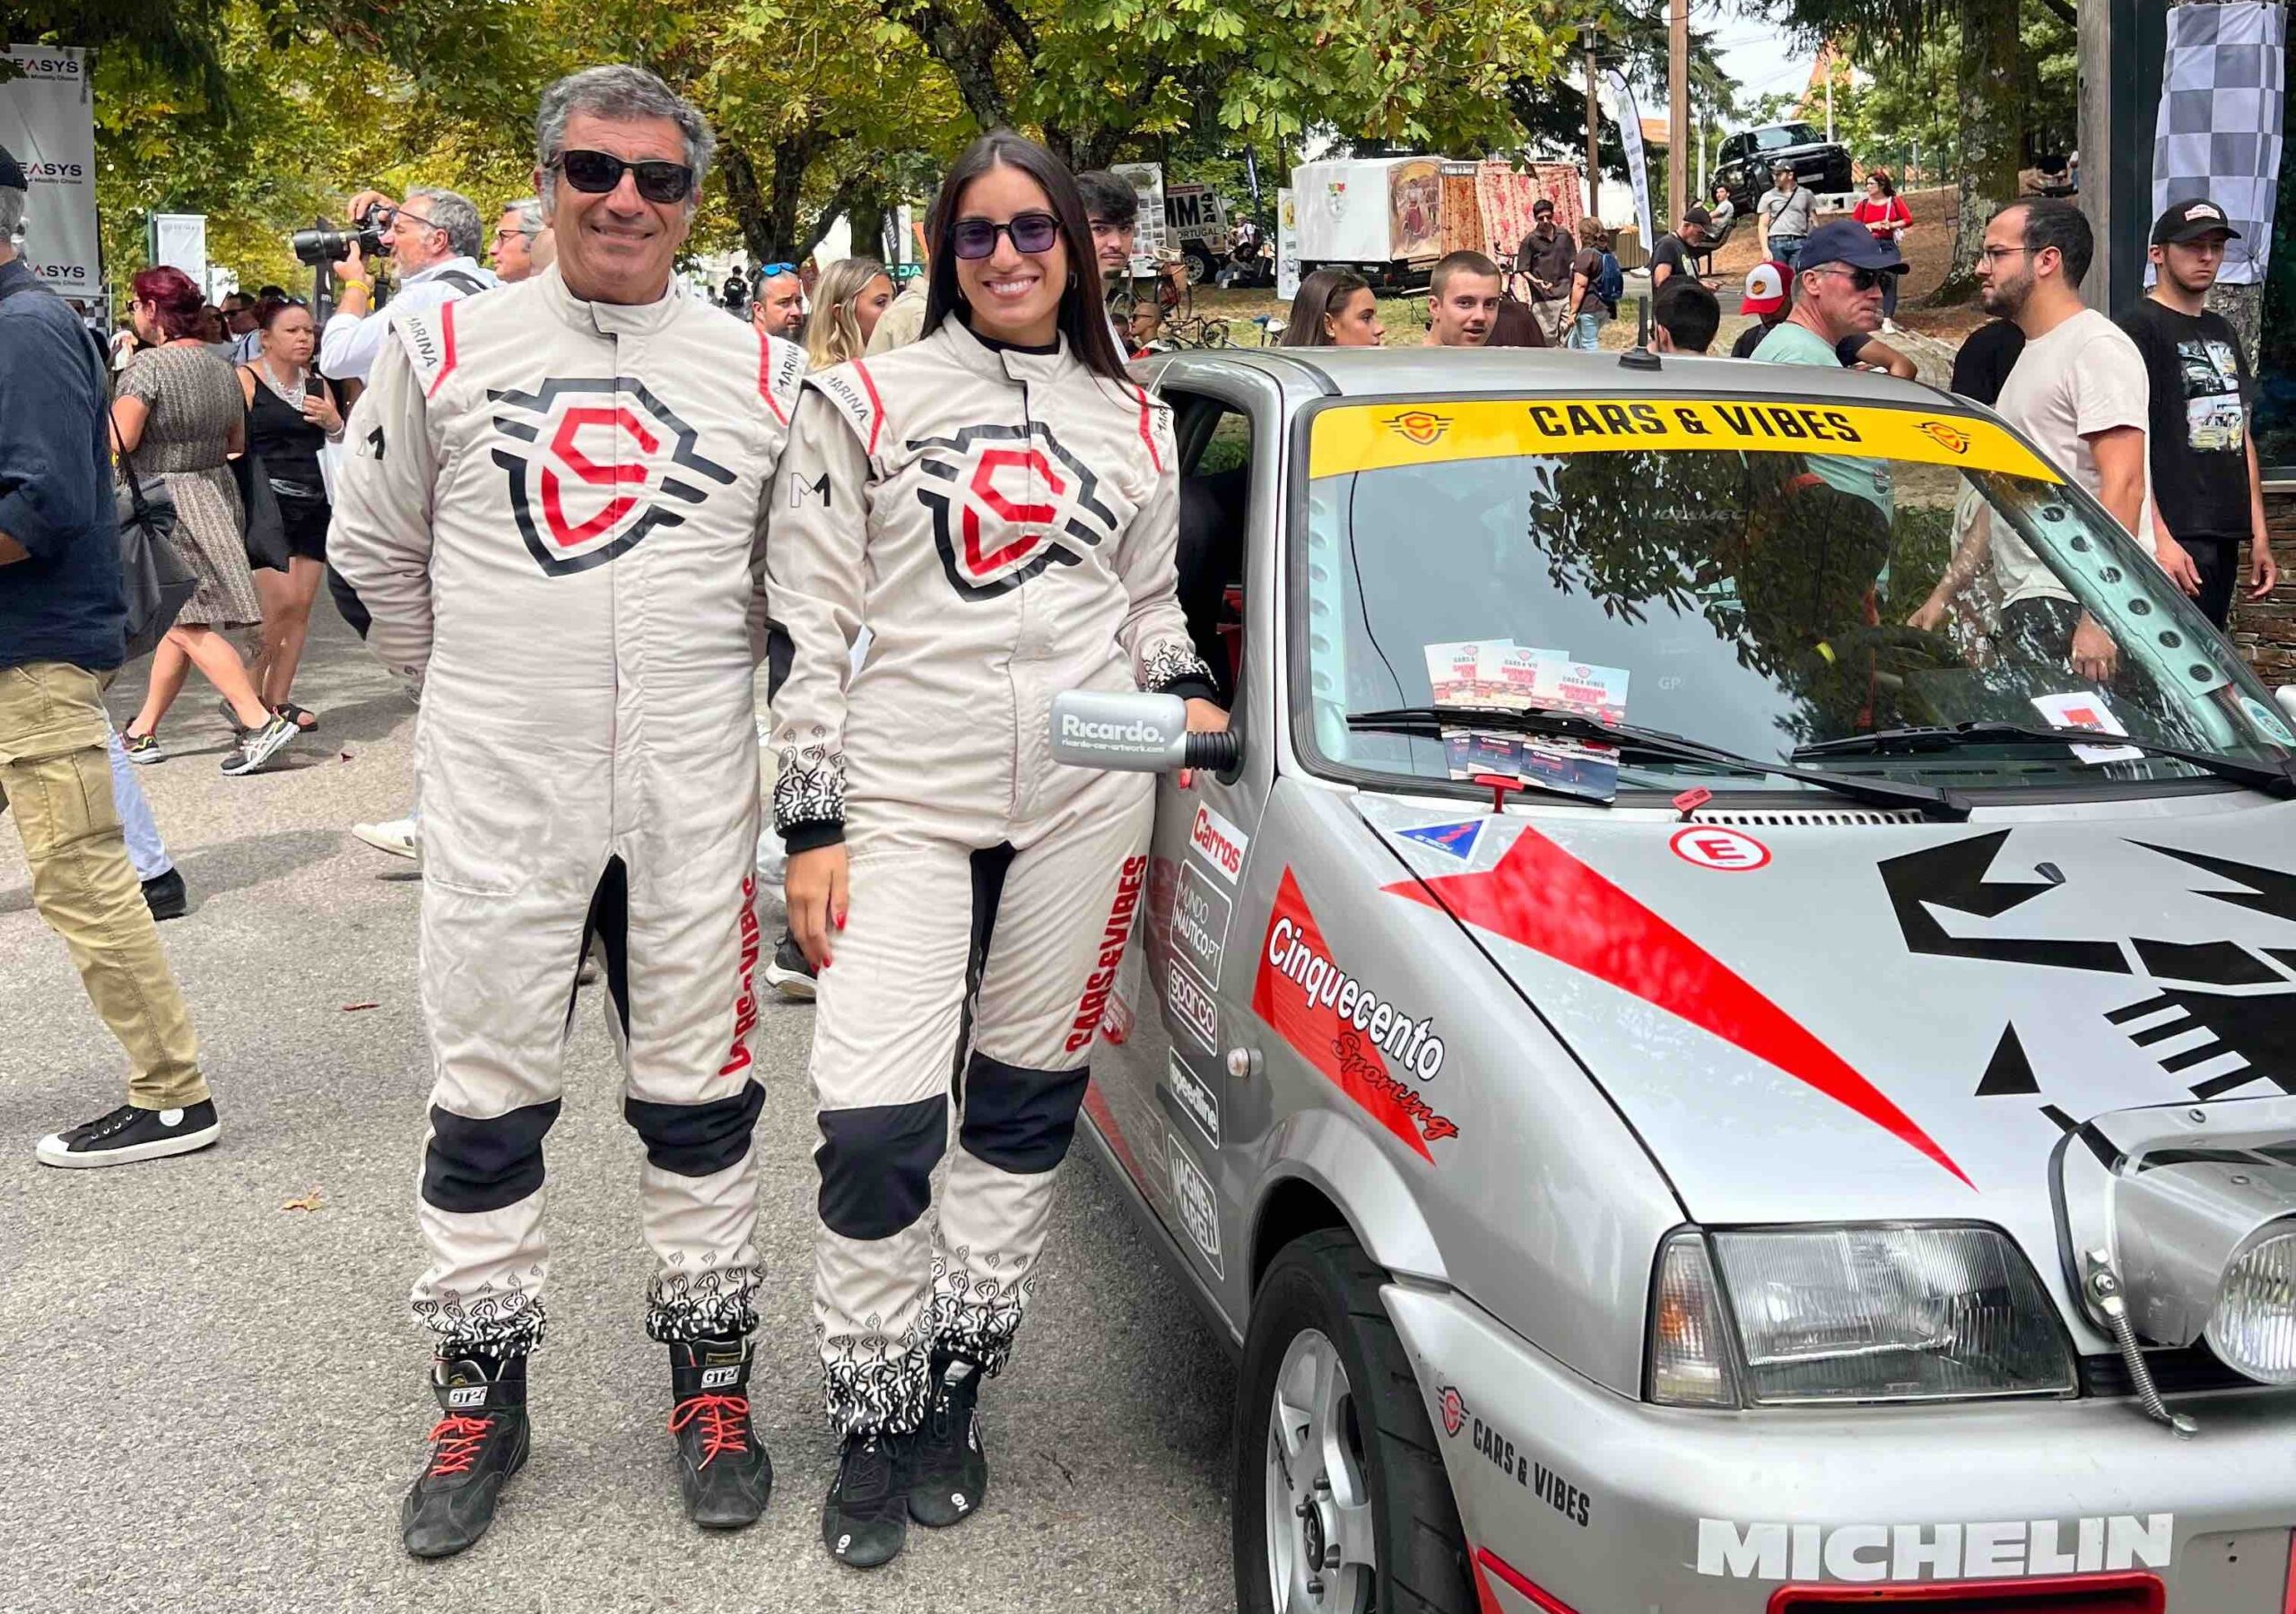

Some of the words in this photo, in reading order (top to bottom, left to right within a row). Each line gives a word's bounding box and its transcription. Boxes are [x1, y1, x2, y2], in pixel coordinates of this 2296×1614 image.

[16, 161, 83, 177] EASYS
[1177, 227, 1220, 239] ORTUGAL
[1528, 404, 1668, 436] CARS
[1673, 408, 1713, 435] &
[1712, 404, 1862, 442] VIBES
[1062, 713, 1165, 743] Ricardo.
[1194, 808, 1240, 873] Carros
[1694, 839, 1748, 860] E
[1176, 881, 1209, 924] MUNDO
[1170, 968, 1214, 1034] sparco
[1268, 916, 1446, 1081] Cinquecento
[1170, 1063, 1217, 1133] speedline
[1332, 1031, 1460, 1141] Sporting
[1473, 1418, 1514, 1475] CARS
[1517, 1455, 1528, 1487] &
[1535, 1462, 1590, 1527] VIBES
[1697, 1513, 2174, 1582] MICHELIN
